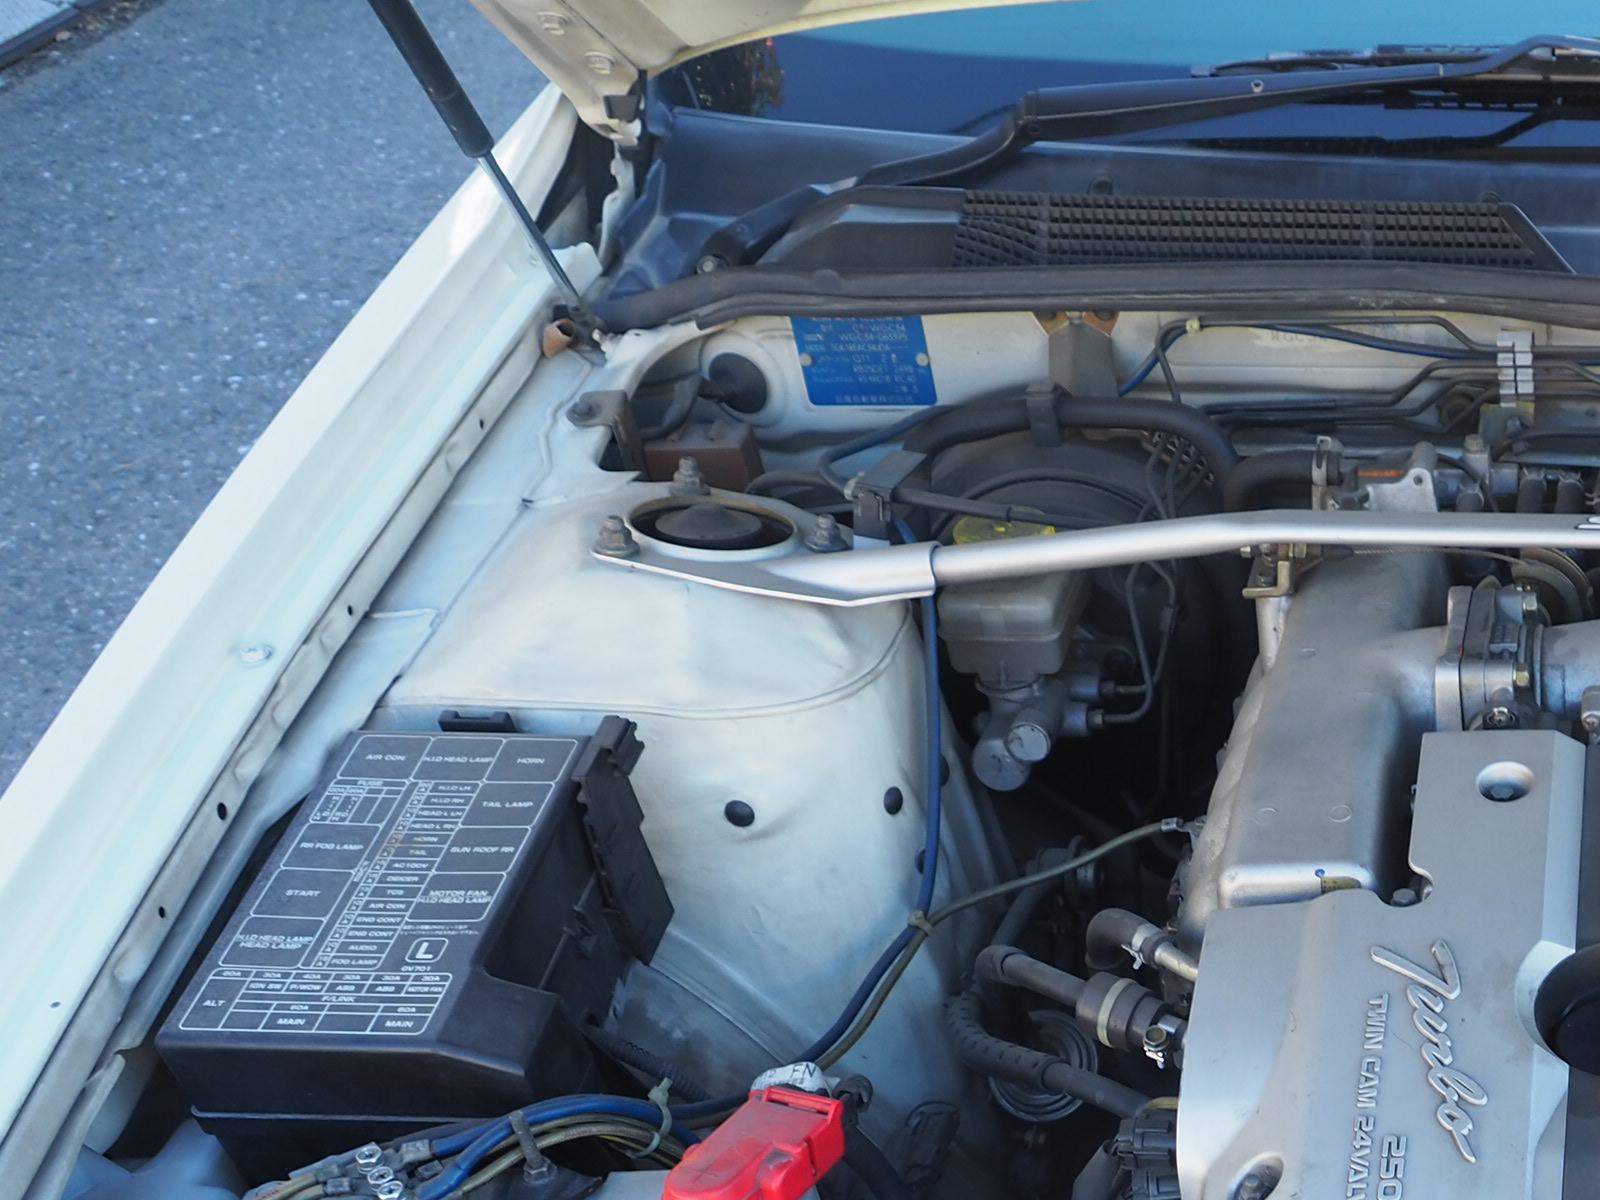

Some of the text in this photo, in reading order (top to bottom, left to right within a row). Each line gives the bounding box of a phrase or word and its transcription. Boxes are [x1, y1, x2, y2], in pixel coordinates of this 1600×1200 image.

[415, 942, 434, 959] L
[1364, 992, 1390, 1050] TWIN
[1371, 939, 1489, 1163] Turbo
[1357, 1055, 1382, 1108] CAM
